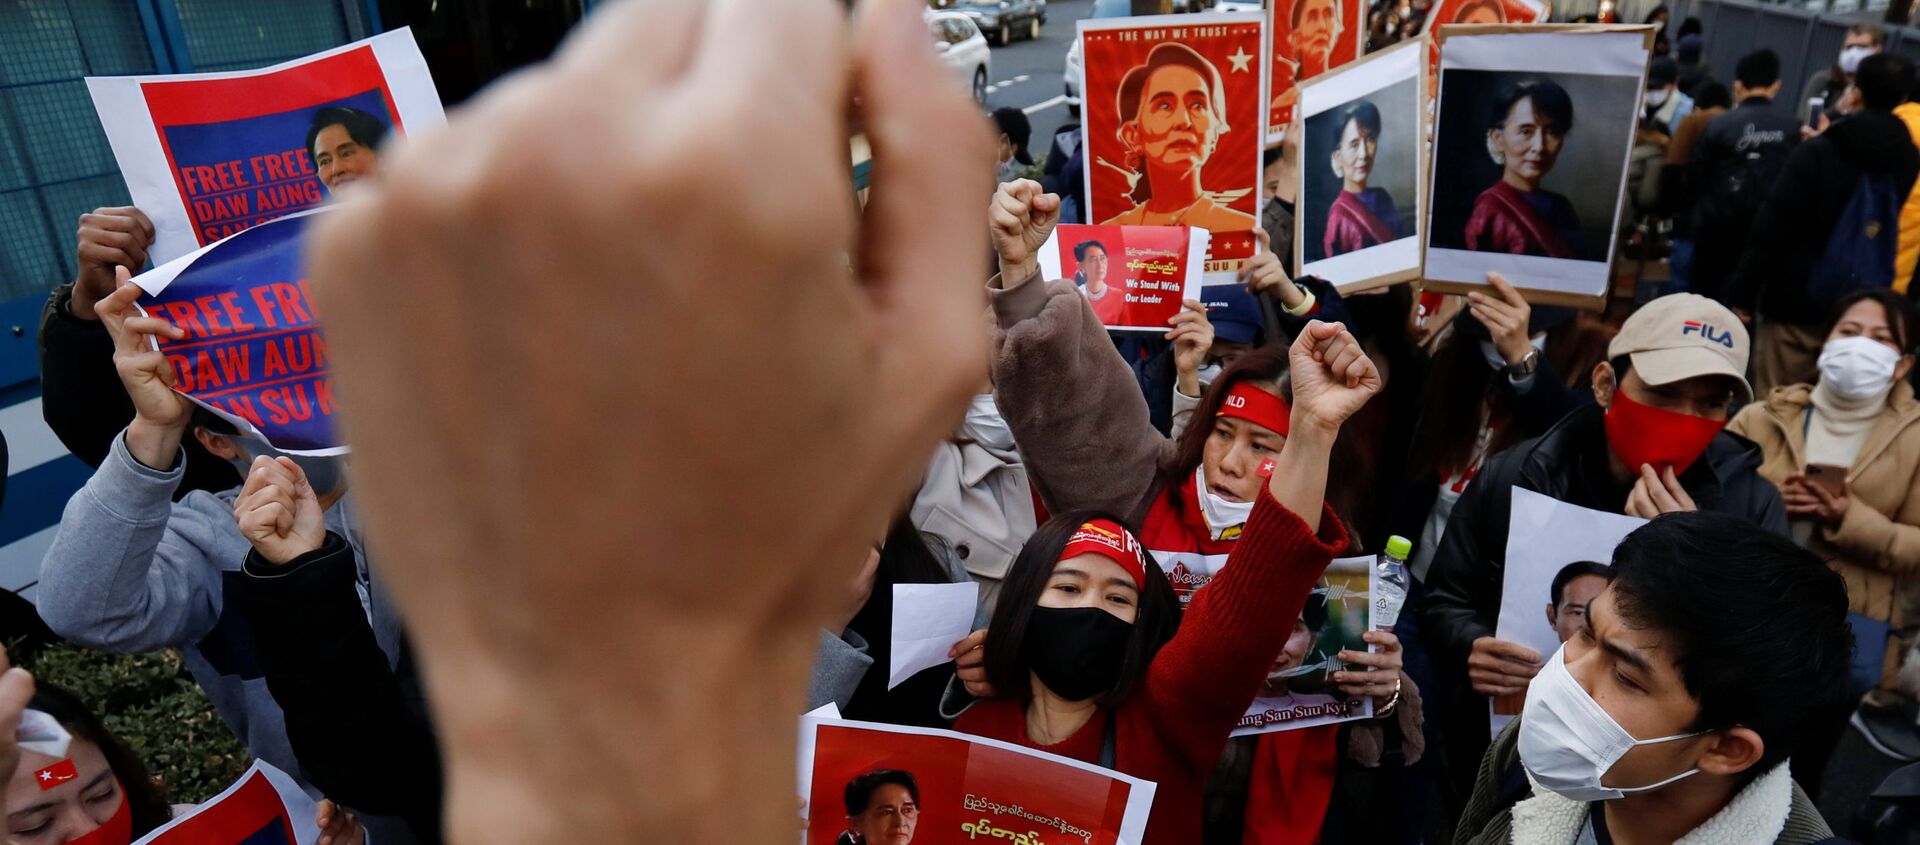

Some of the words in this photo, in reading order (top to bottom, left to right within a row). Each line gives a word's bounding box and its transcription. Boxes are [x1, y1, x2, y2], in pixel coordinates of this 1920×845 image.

[1118, 31, 1138, 41] THE
[1144, 30, 1167, 40] WAY
[1173, 28, 1188, 39] WE
[1194, 26, 1228, 37] TRUST
[182, 165, 249, 195] FREE
[250, 148, 314, 183] FREE
[194, 193, 249, 222] DAW
[256, 181, 321, 211] AUNG
[1204, 262, 1229, 272] SUU
[1125, 293, 1139, 302] Our
[1140, 294, 1163, 304] Leader
[1126, 279, 1138, 288] We
[1140, 279, 1160, 289] Stand
[1161, 281, 1180, 292] With
[144, 292, 254, 344] FREE
[250, 279, 321, 328] FRE
[1683, 320, 1733, 348] FILA
[169, 344, 250, 394] DAW
[264, 333, 333, 377] AUN
[260, 383, 312, 425] SU
[1225, 395, 1245, 408] NLD
[1237, 713, 1263, 726] ung
[1265, 710, 1291, 723] San
[1295, 706, 1321, 718] Suu
[1325, 702, 1347, 715] Kyi
